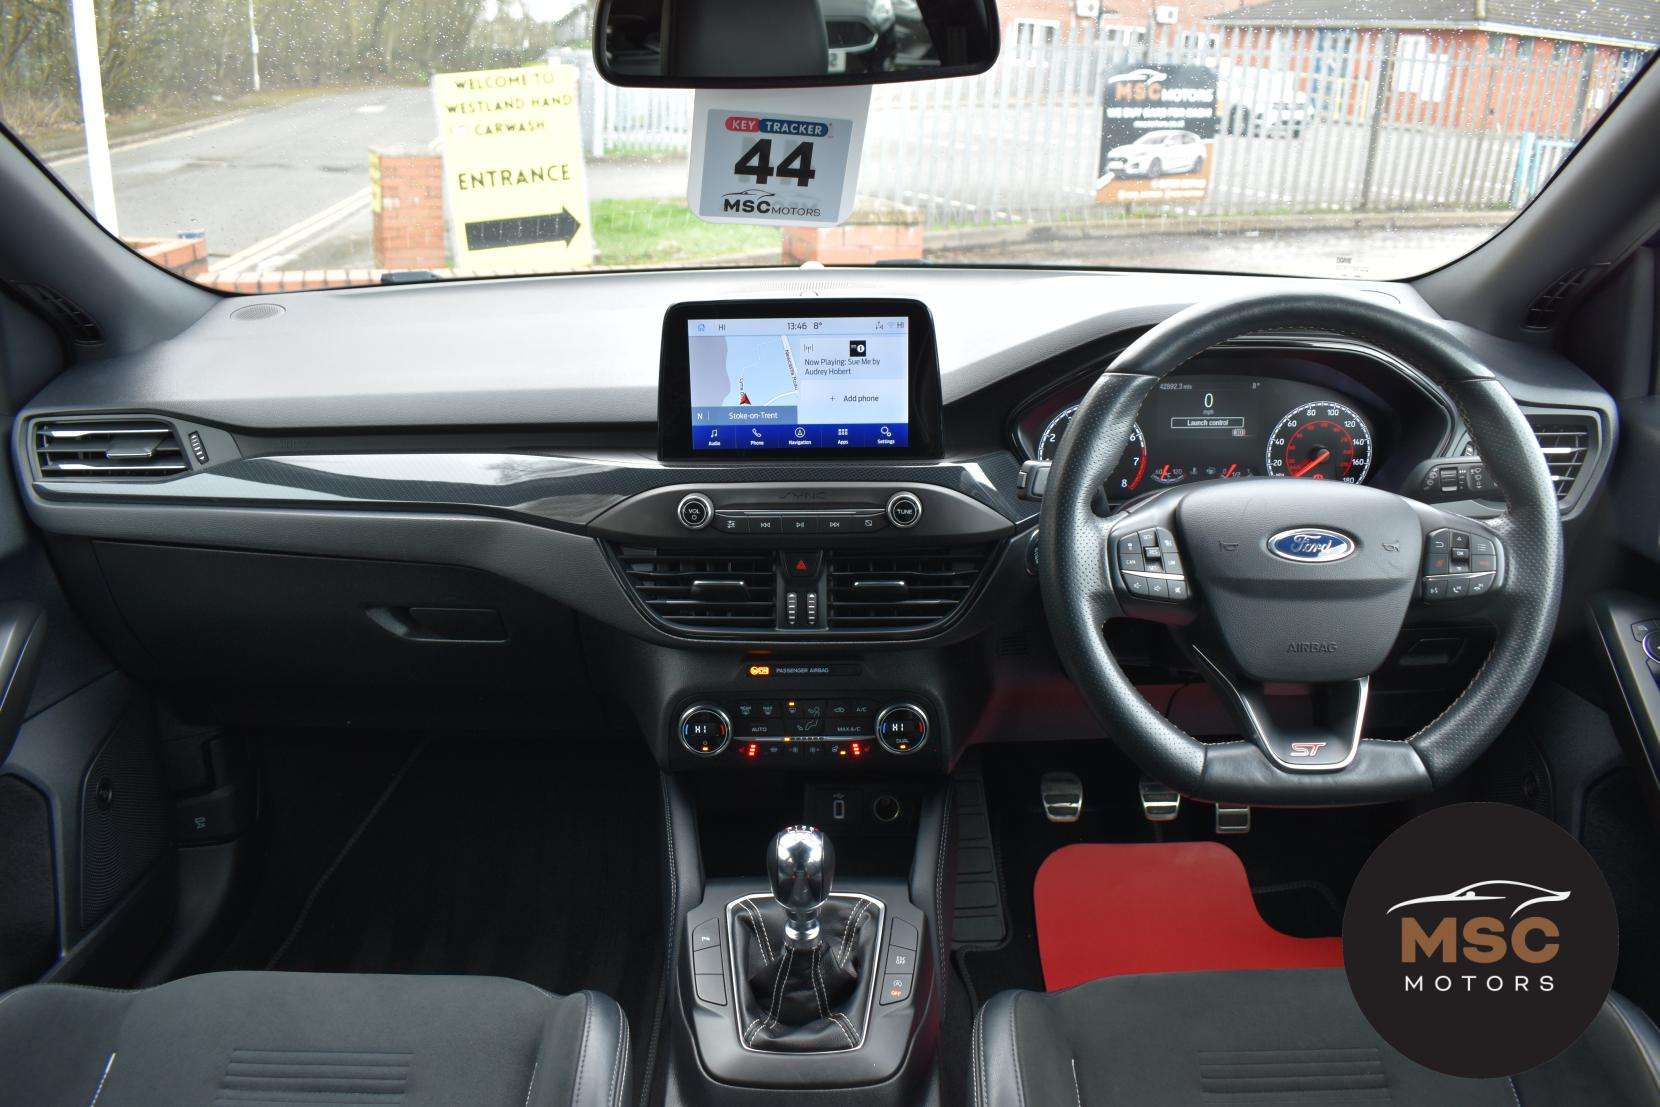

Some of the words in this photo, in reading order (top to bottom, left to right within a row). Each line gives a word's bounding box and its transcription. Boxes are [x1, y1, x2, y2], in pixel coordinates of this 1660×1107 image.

[456, 74, 527, 89] WELCOME
[535, 72, 554, 84] TO
[1115, 82, 1162, 101] MSC
[446, 97, 524, 114] WESTLAND
[531, 94, 573, 106] HAND
[474, 120, 545, 136] CARWASH
[732, 119, 757, 130] KEY
[766, 121, 822, 136] TRACKER
[734, 138, 816, 187] 44
[458, 164, 571, 190] ENTRANCE
[724, 198, 771, 214] MSC
[771, 206, 822, 216] MOTORS
[718, 324, 726, 332] HI
[787, 322, 808, 330] 13:46
[813, 322, 822, 330] 8°
[820, 358, 846, 368] Playing:
[872, 358, 880, 366] by
[804, 368, 828, 376] Audrey
[857, 394, 879, 404] phone
[1204, 393, 1214, 408] 0
[697, 412, 703, 420] N
[728, 412, 778, 420] Stoke-on-Trent
[1050, 434, 1056, 442] 2
[1130, 432, 1136, 442] 6
[1134, 457, 1140, 466] 7
[1121, 478, 1128, 488] 8
[1291, 534, 1334, 553] Ford
[1287, 642, 1338, 654] AIRBAG
[694, 725, 707, 734] HI
[892, 723, 904, 732] HI
[1290, 742, 1326, 756] ST
